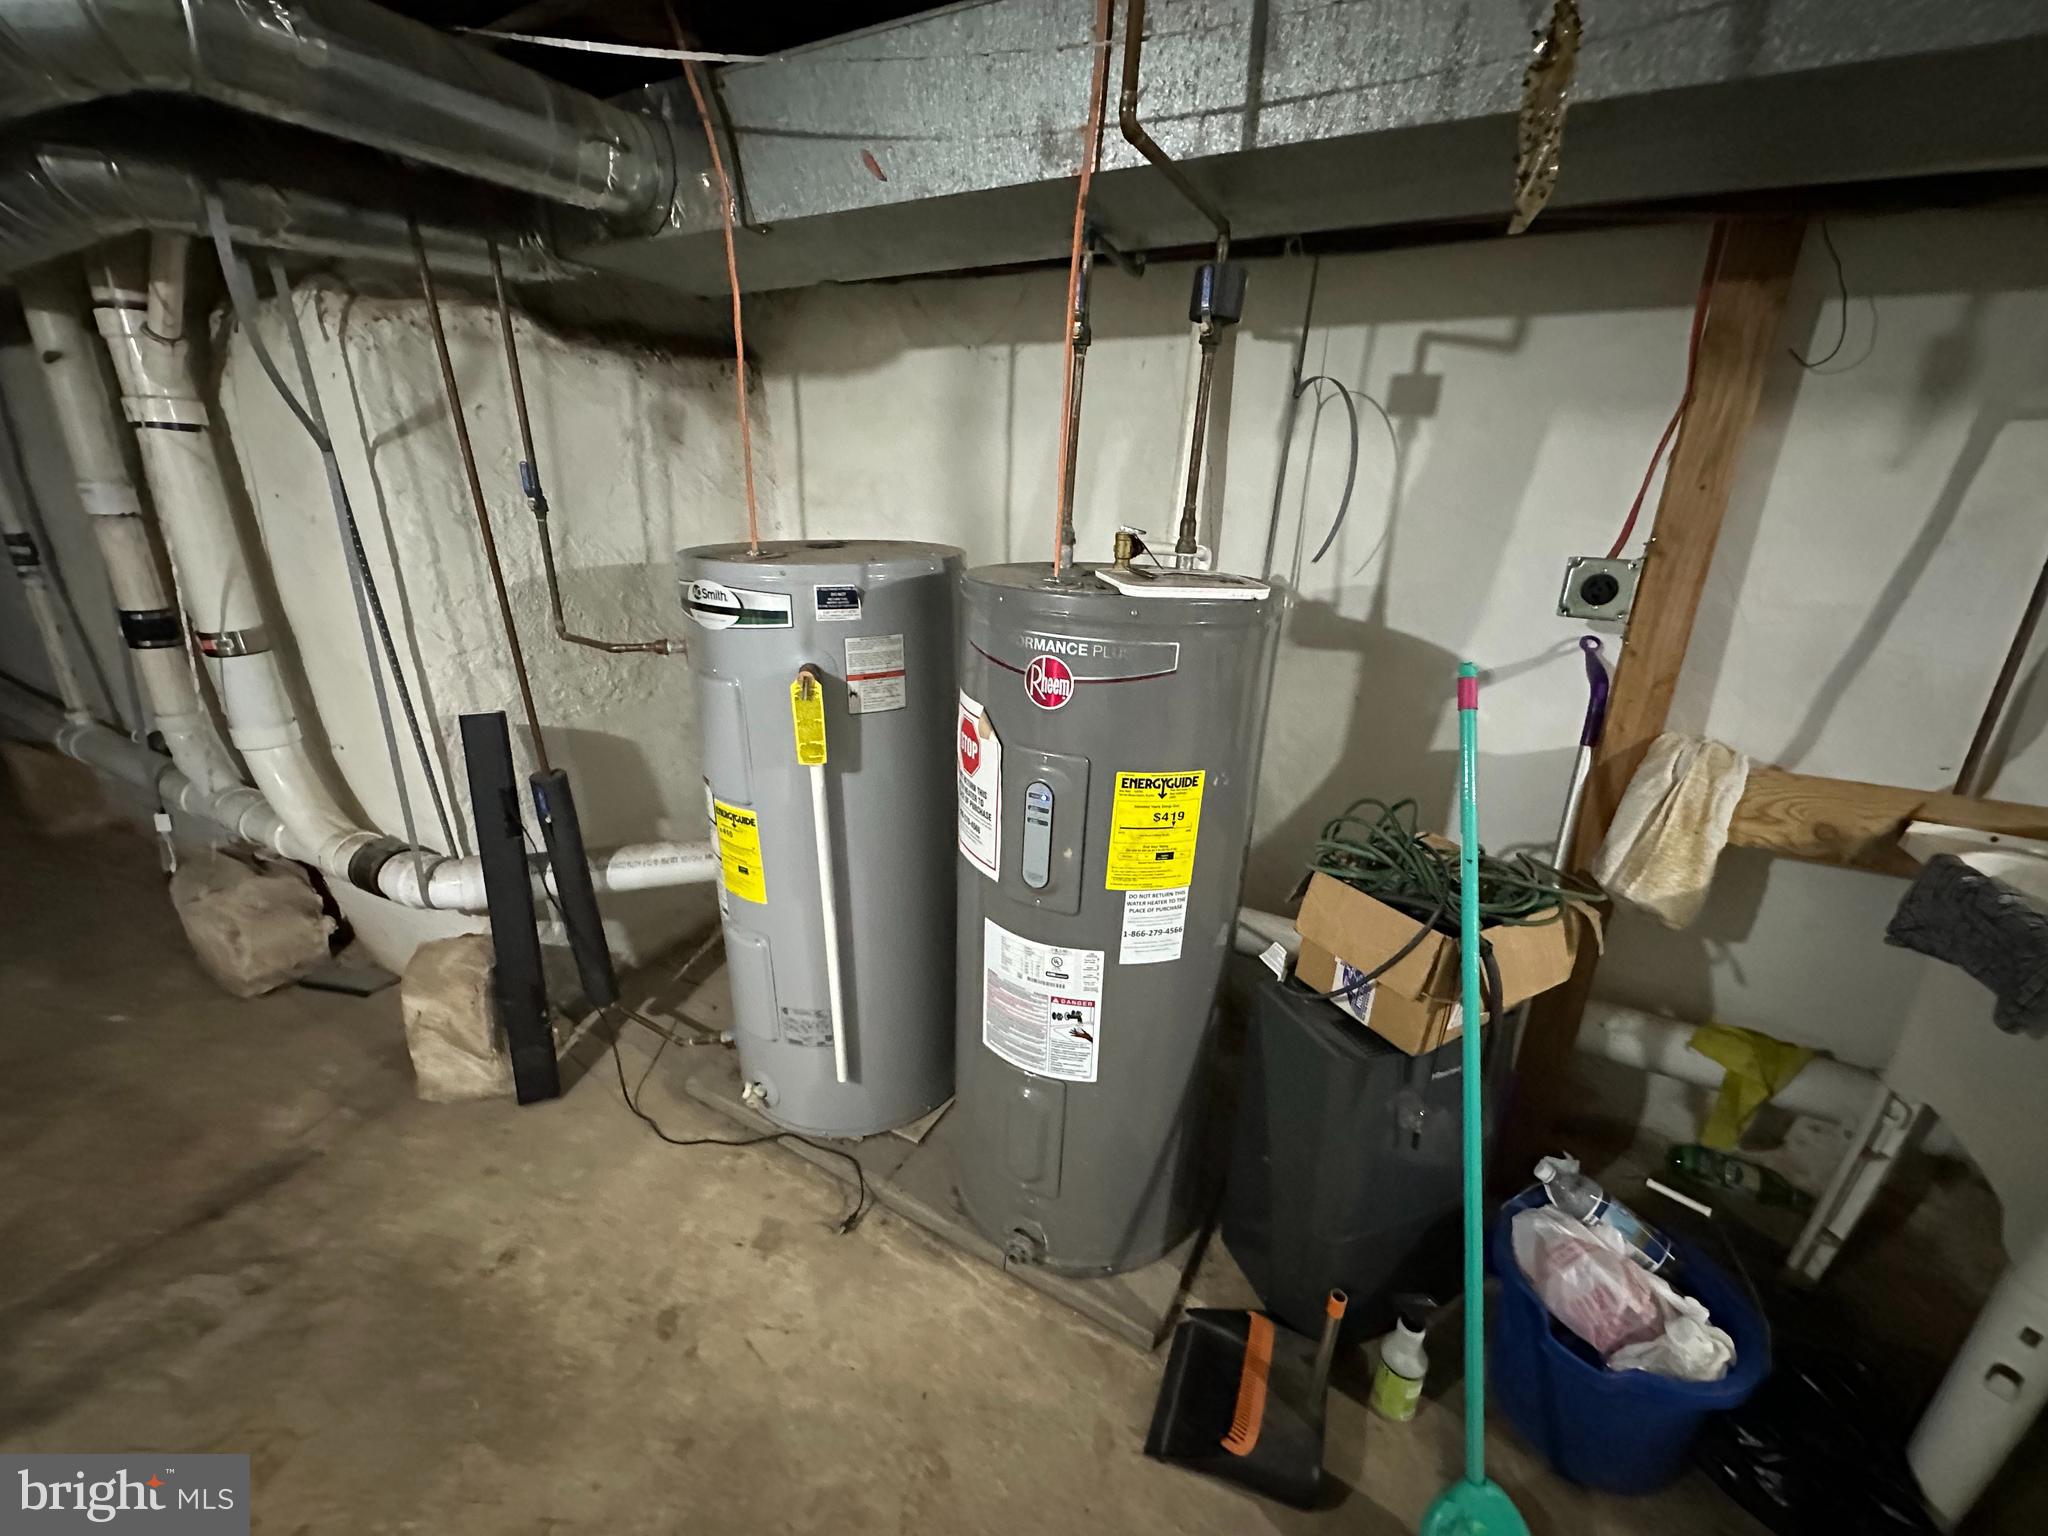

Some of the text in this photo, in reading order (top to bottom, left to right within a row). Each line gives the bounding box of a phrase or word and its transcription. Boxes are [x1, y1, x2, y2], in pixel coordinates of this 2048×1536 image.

[1030, 657, 1070, 700] Rheem
[960, 731, 978, 760] STOP
[1153, 811, 1185, 823] $419
[1156, 904, 1182, 912] PURCHASE
[1123, 926, 1183, 938] 1-866-279-4566
[1060, 999, 1093, 1007] DANGER
